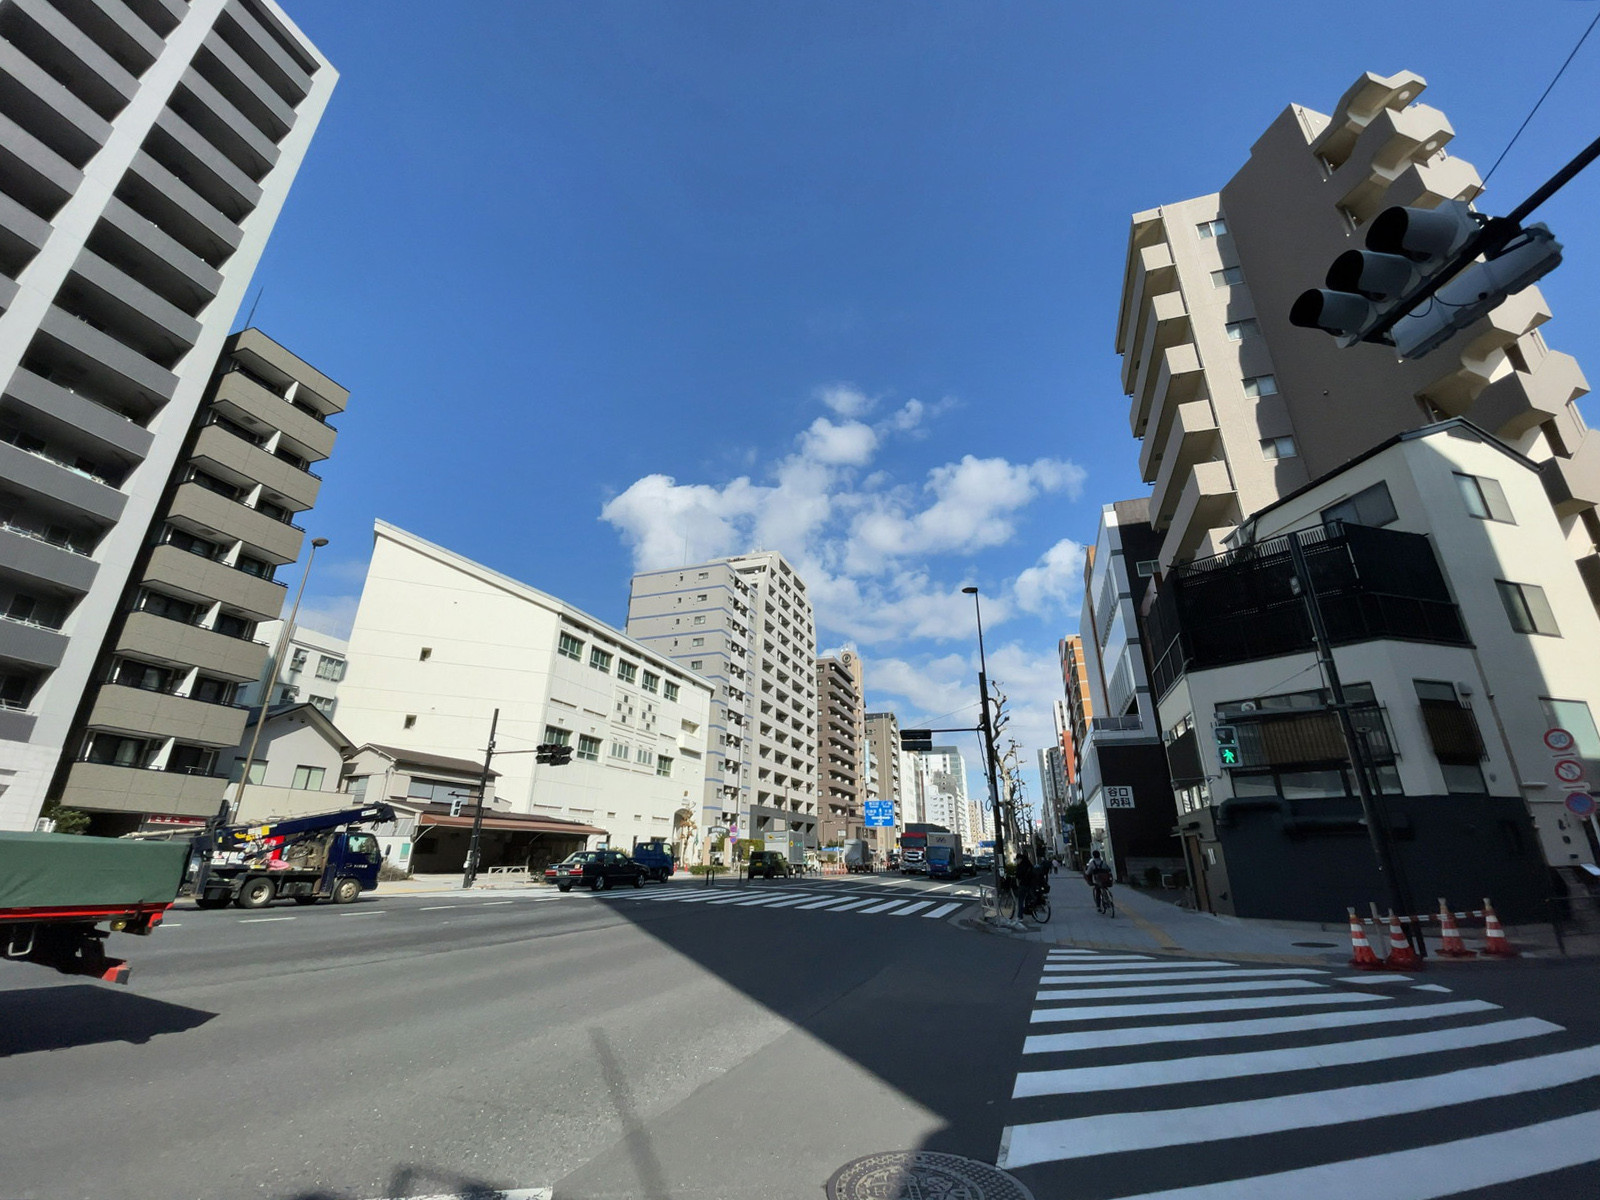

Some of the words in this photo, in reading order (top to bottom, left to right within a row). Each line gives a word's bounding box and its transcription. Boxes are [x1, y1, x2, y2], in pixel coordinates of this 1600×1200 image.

[1550, 734, 1568, 745] 30
[1107, 787, 1129, 797] 谷口
[1110, 797, 1131, 807] 内科
